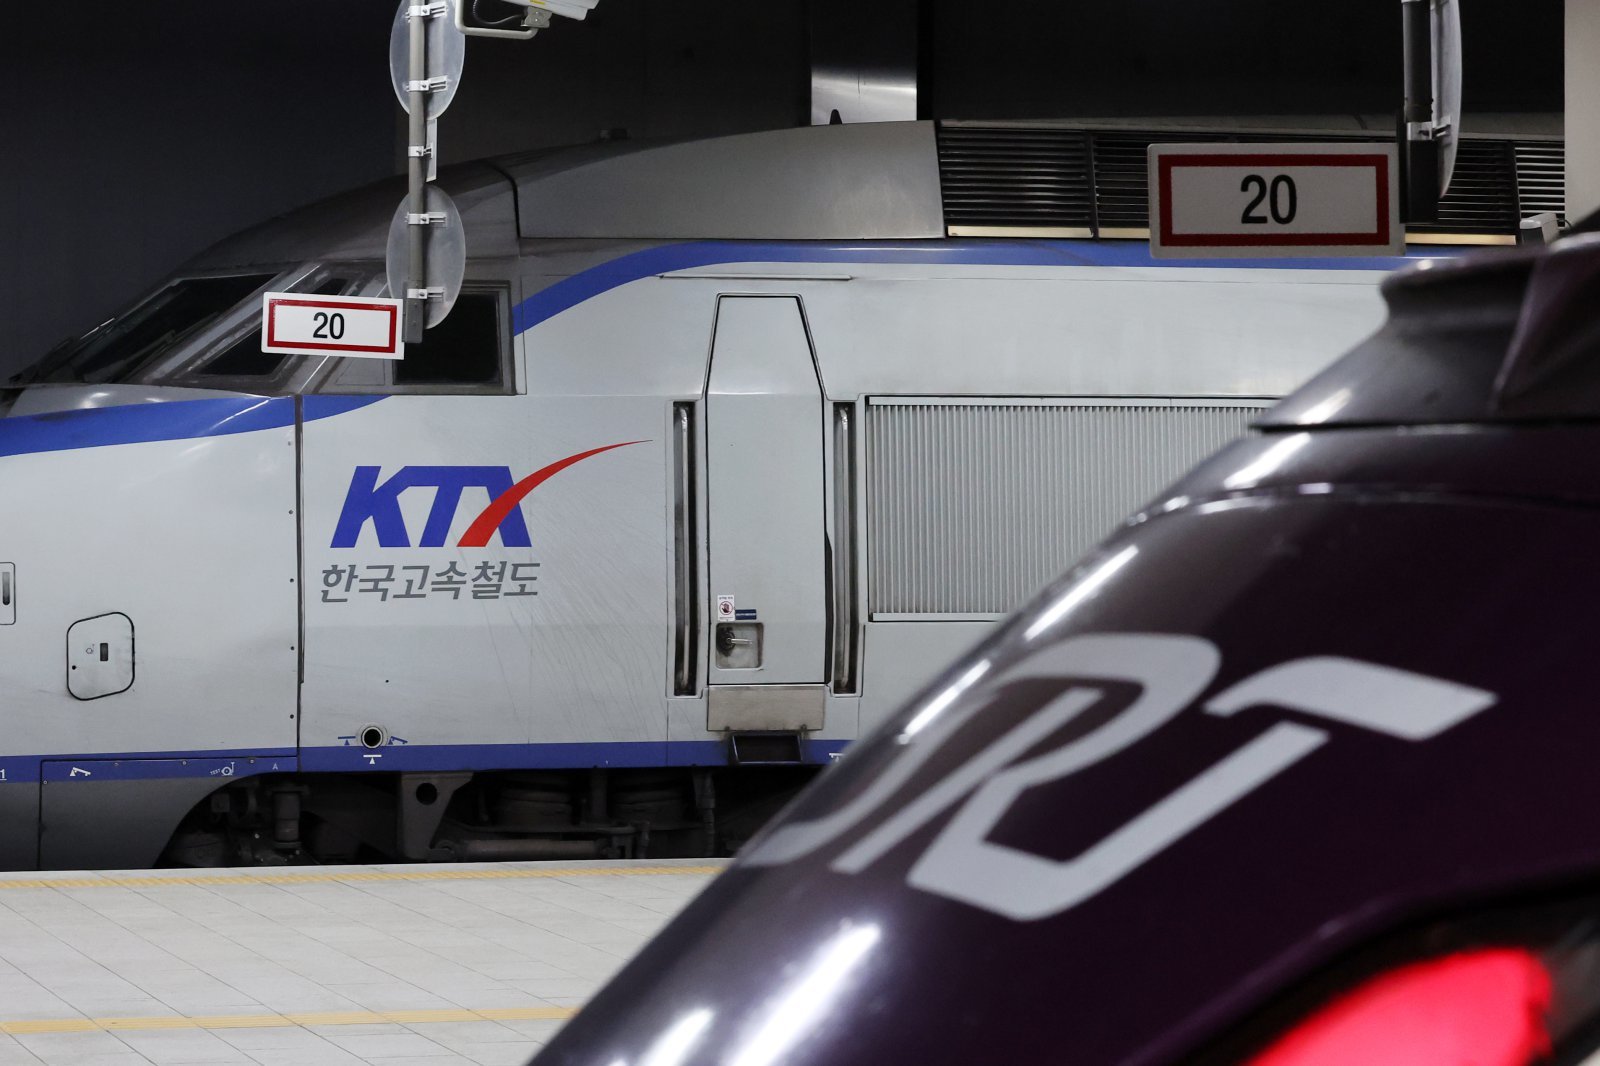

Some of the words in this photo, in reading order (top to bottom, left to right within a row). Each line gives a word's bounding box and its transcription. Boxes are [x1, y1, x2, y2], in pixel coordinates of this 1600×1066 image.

[1240, 174, 1297, 225] 20
[312, 312, 345, 340] 20
[320, 561, 541, 603] 한국고속철도
